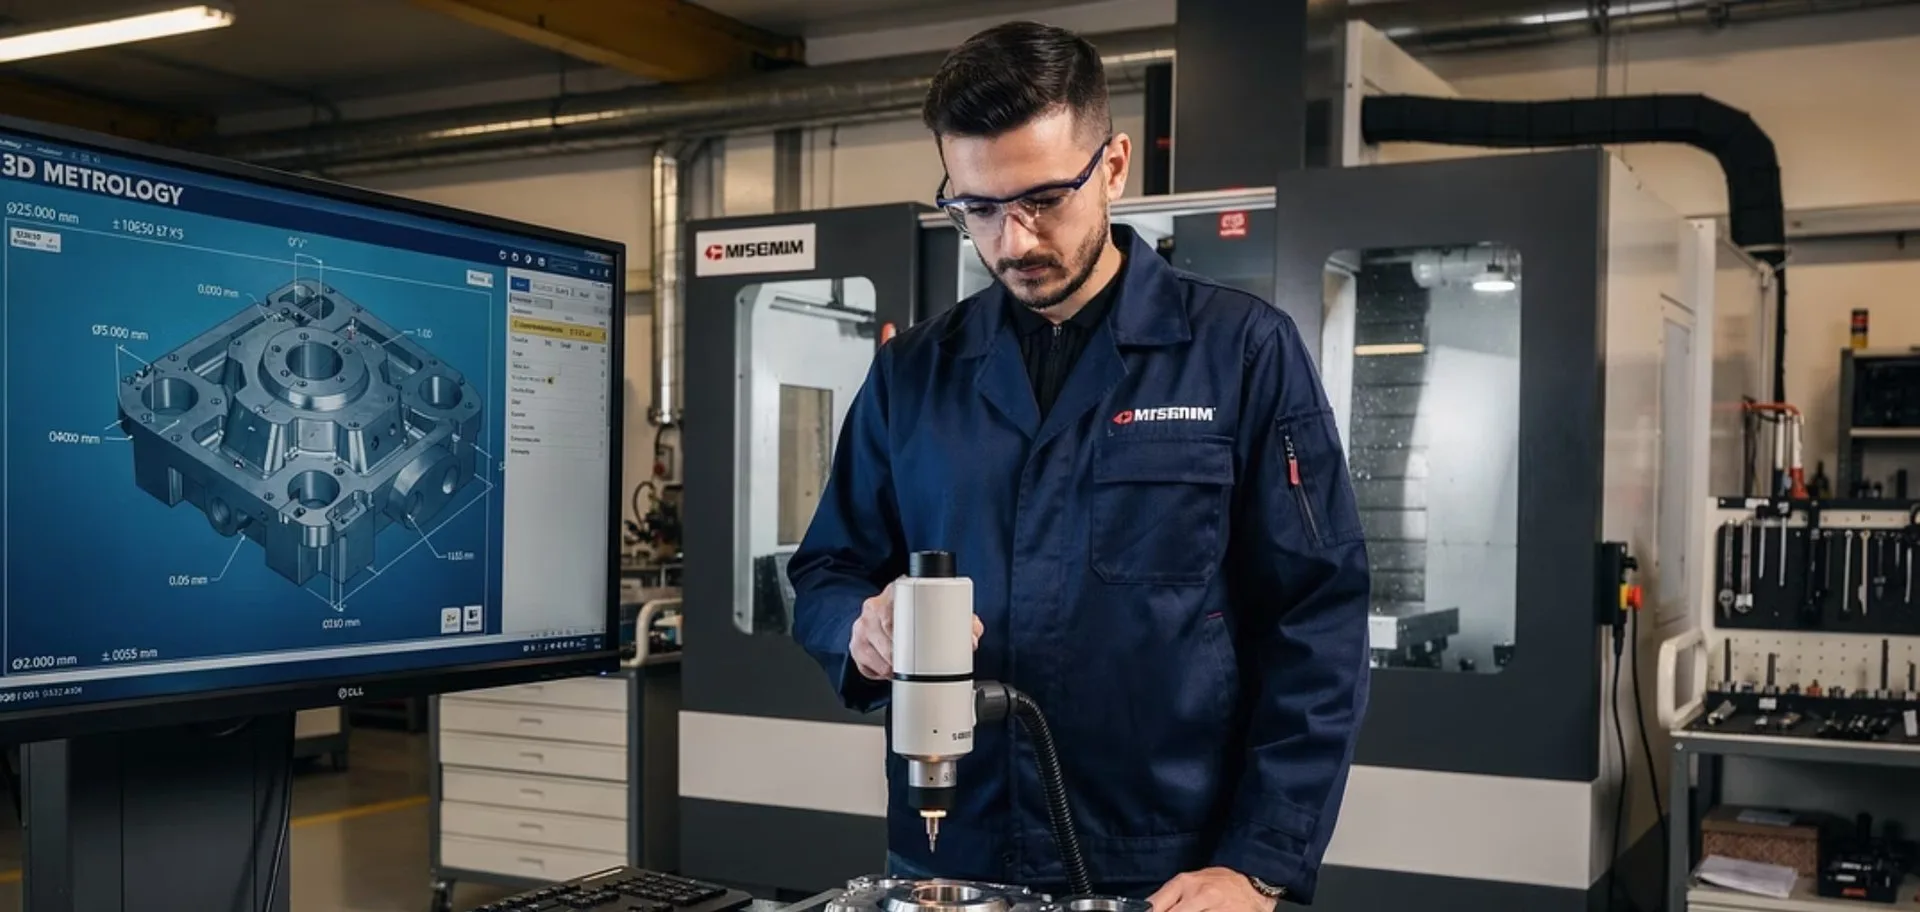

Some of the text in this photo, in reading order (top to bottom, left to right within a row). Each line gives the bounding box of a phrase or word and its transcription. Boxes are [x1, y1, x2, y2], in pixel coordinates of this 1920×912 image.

[2, 153, 183, 205] 3D METROLOGY
[58, 212, 79, 224] mm
[130, 331, 149, 340] mm
[139, 649, 158, 658] mm
[56, 656, 78, 665] mm
